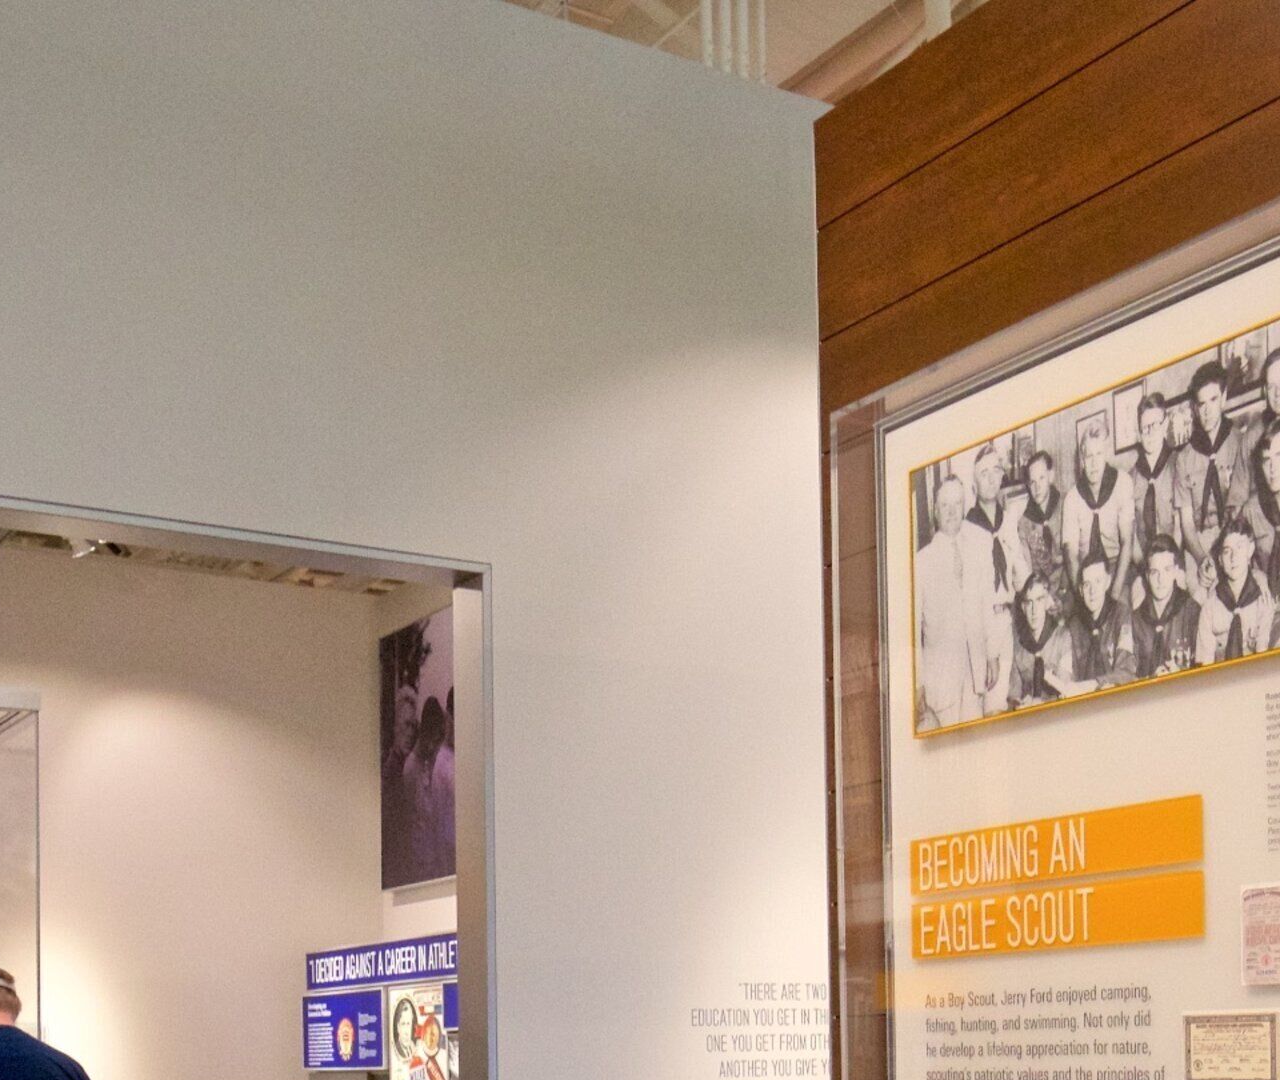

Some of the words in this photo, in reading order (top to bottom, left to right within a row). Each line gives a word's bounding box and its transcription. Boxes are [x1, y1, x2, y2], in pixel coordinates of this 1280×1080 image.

[920, 825, 1039, 891] BECOMING
[1049, 817, 1086, 874] AN
[920, 899, 996, 955] EAGLE
[1006, 887, 1094, 946] SCOUT
[377, 950, 384, 976] A
[418, 944, 426, 972] IN
[781, 983, 800, 1001] ARE
[806, 983, 827, 1000] TWO
[925, 994, 937, 1008] As
[939, 997, 945, 1007] a
[948, 994, 964, 1010] Boy
[1001, 990, 1027, 1009] Jerry
[1030, 988, 1052, 1004] Ford
[1056, 985, 1097, 1005] enjoyed
[1101, 983, 1151, 1003] camping,
[691, 1008, 750, 1027] EDUCATION
[753, 1008, 773, 1026] YOU
[777, 1008, 797, 1026] GET
[801, 1008, 810, 1026] IN
[960, 1017, 999, 1034] hunting,
[1002, 1016, 1021, 1031] and
[1024, 1016, 1079, 1033] swimming.
[1083, 1012, 1103, 1029] Not
[1106, 1011, 1130, 1030] only
[1134, 1010, 1151, 1027] did
[706, 1034, 728, 1052] ONE
[732, 1034, 752, 1052] YOU
[755, 1034, 776, 1052] GET
[779, 1034, 807, 1051] FROM
[926, 1043, 937, 1057] he
[940, 1043, 975, 1060] develop
[978, 1046, 984, 1057] a
[987, 1042, 1022, 1059] lifelong
[1026, 1041, 1089, 1060] appreciation
[1093, 1040, 1108, 1055] for
[1112, 1041, 1152, 1057] nature,
[720, 1059, 768, 1078] ANOTHER
[771, 1059, 791, 1077] YOU
[795, 1059, 817, 1076] GIVE
